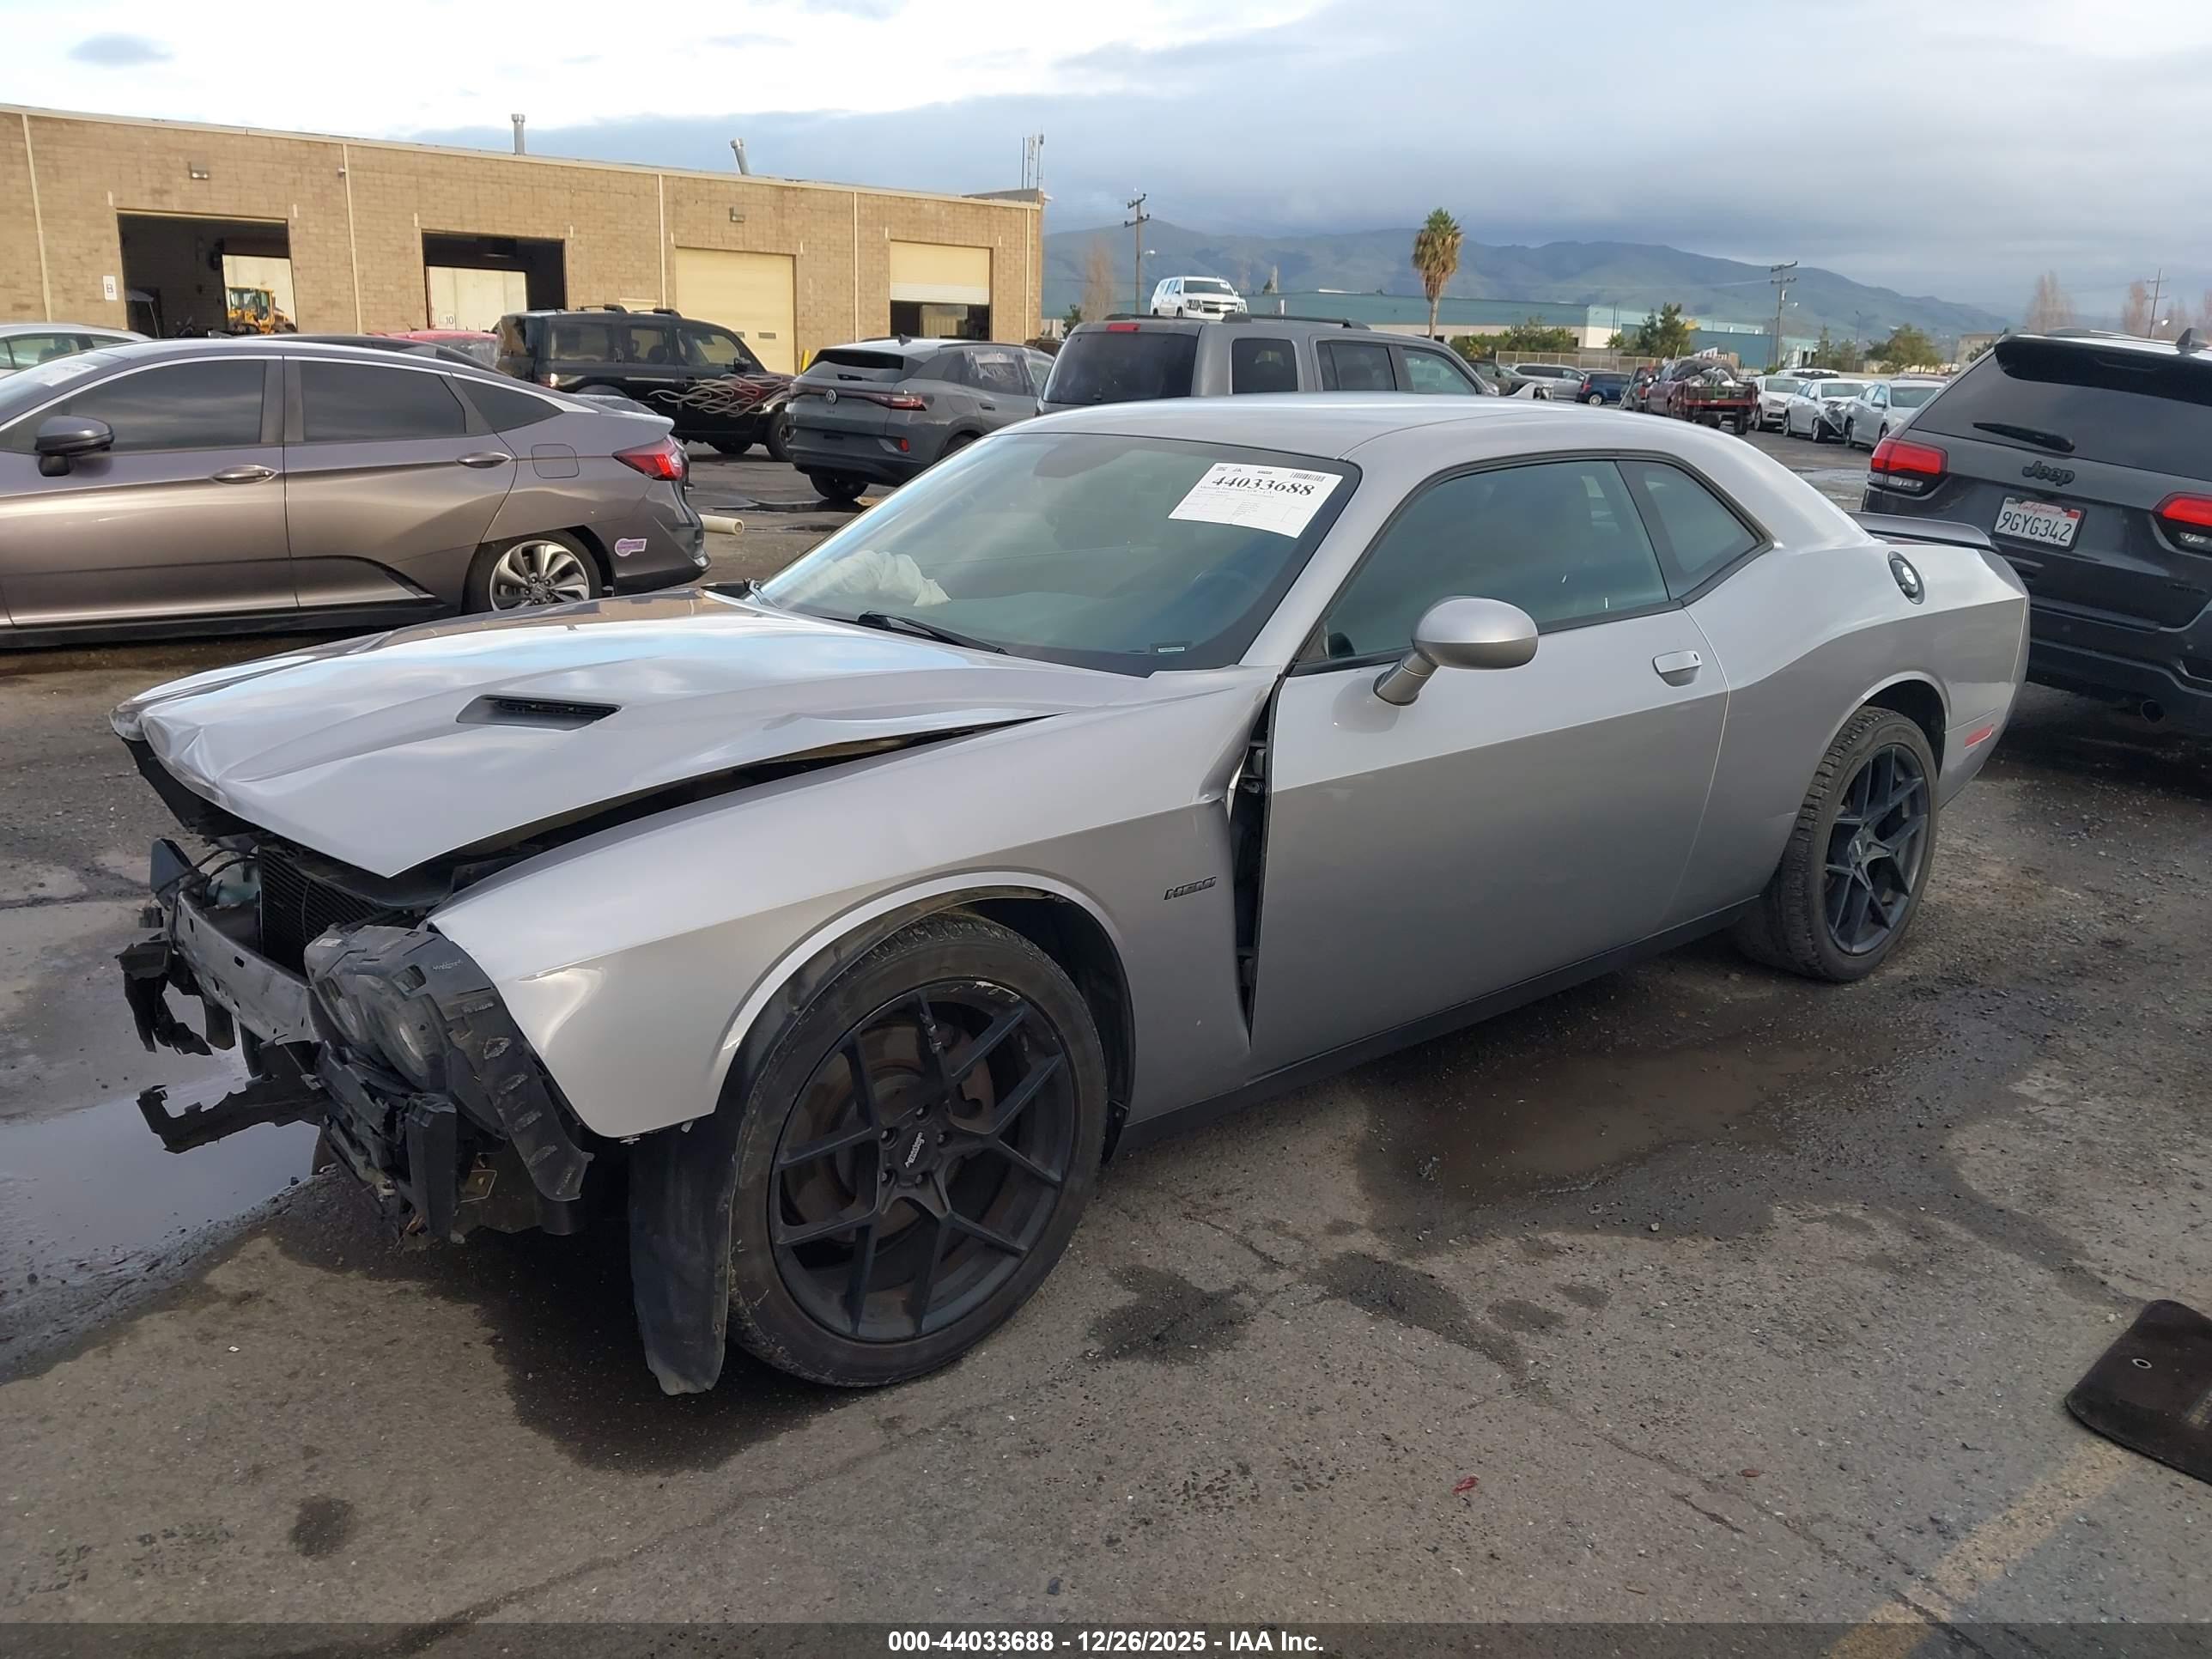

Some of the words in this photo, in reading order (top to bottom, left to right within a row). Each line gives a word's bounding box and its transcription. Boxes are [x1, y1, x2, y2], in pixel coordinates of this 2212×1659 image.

[106, 283, 113, 293] B
[447, 315, 453, 325] 10
[2022, 460, 2075, 487] Jeep
[1212, 476, 1316, 496] 44033688
[1999, 511, 2072, 542] 9GYG342
